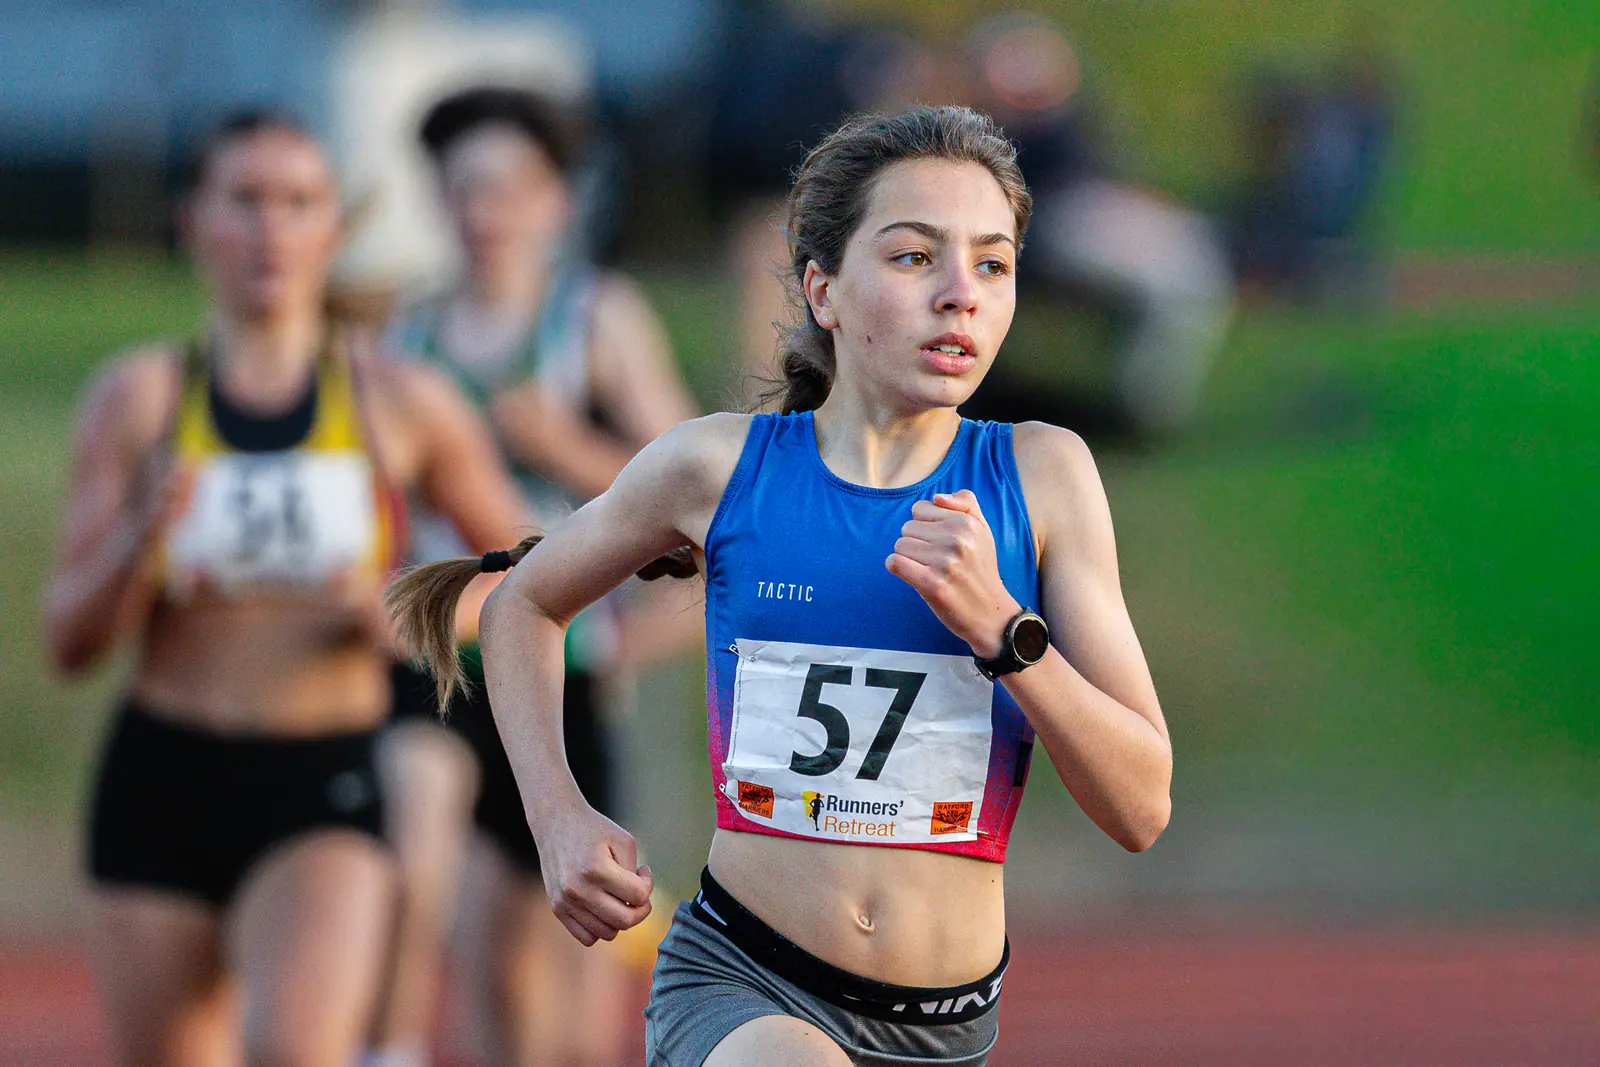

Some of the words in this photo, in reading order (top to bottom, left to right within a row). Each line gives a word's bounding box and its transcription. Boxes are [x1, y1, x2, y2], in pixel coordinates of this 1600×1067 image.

[757, 581, 814, 602] TACTIC
[788, 662, 928, 781] 57
[823, 815, 897, 837] Retreat
